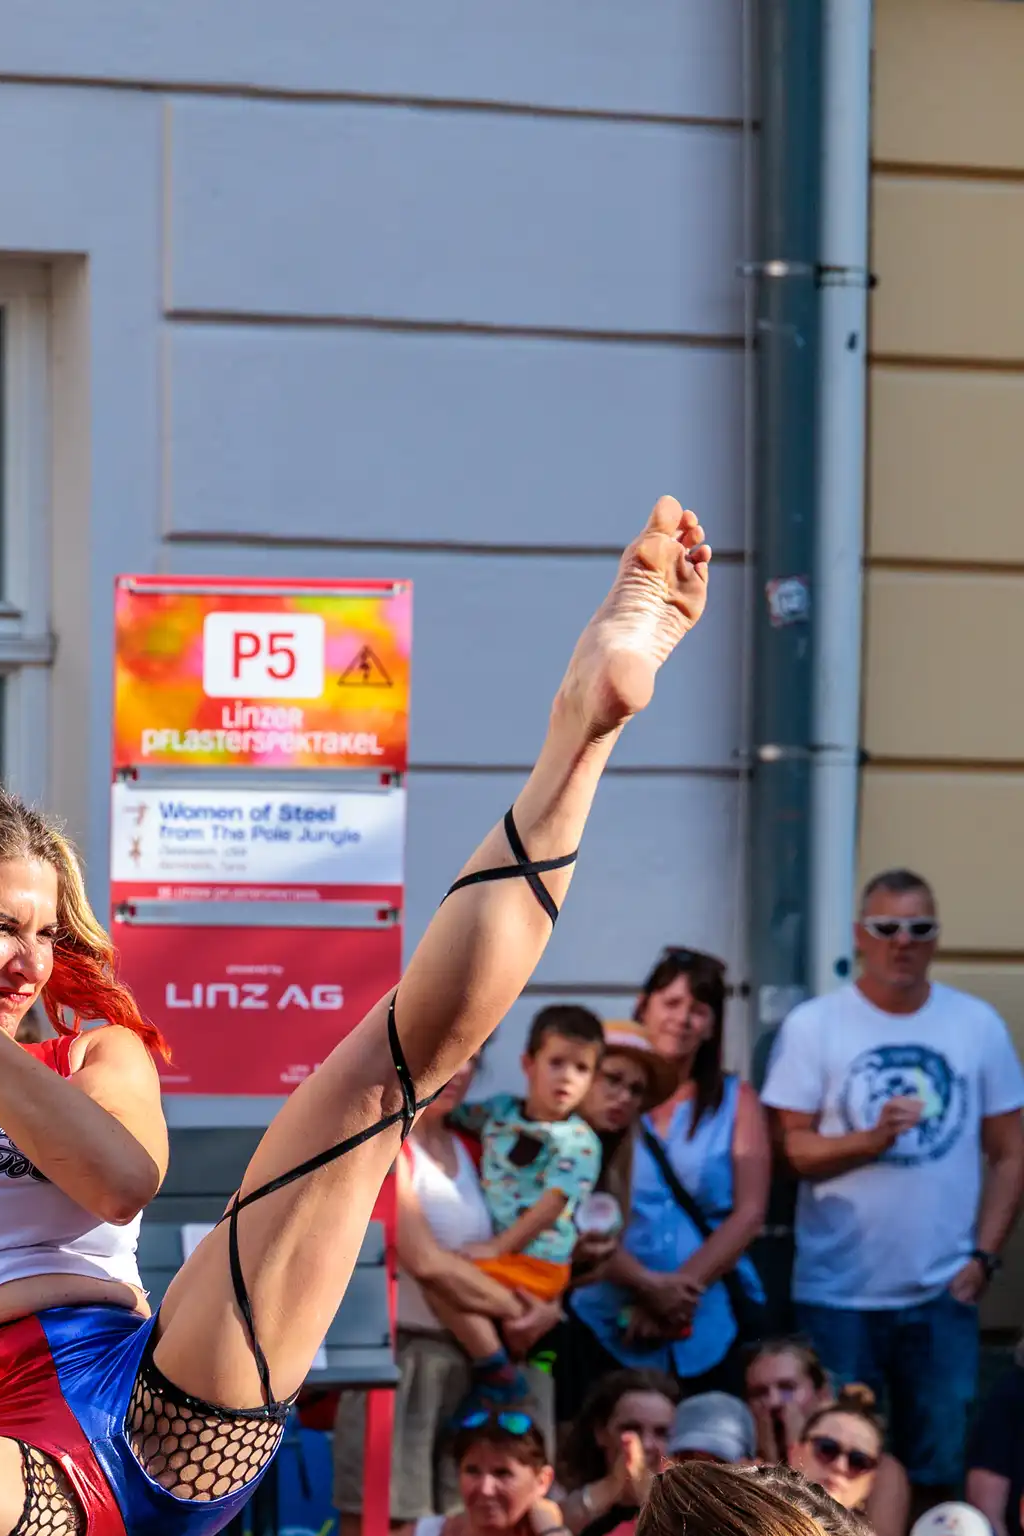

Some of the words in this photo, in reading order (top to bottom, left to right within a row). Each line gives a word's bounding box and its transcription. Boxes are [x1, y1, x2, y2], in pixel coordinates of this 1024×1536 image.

[233, 631, 296, 680] P5
[159, 802, 243, 821] Women
[249, 804, 271, 821] of
[279, 804, 336, 822] Steel
[212, 825, 245, 841] The
[251, 826, 292, 842] Pole
[298, 827, 361, 846] Jungle
[277, 984, 344, 1010] AG
